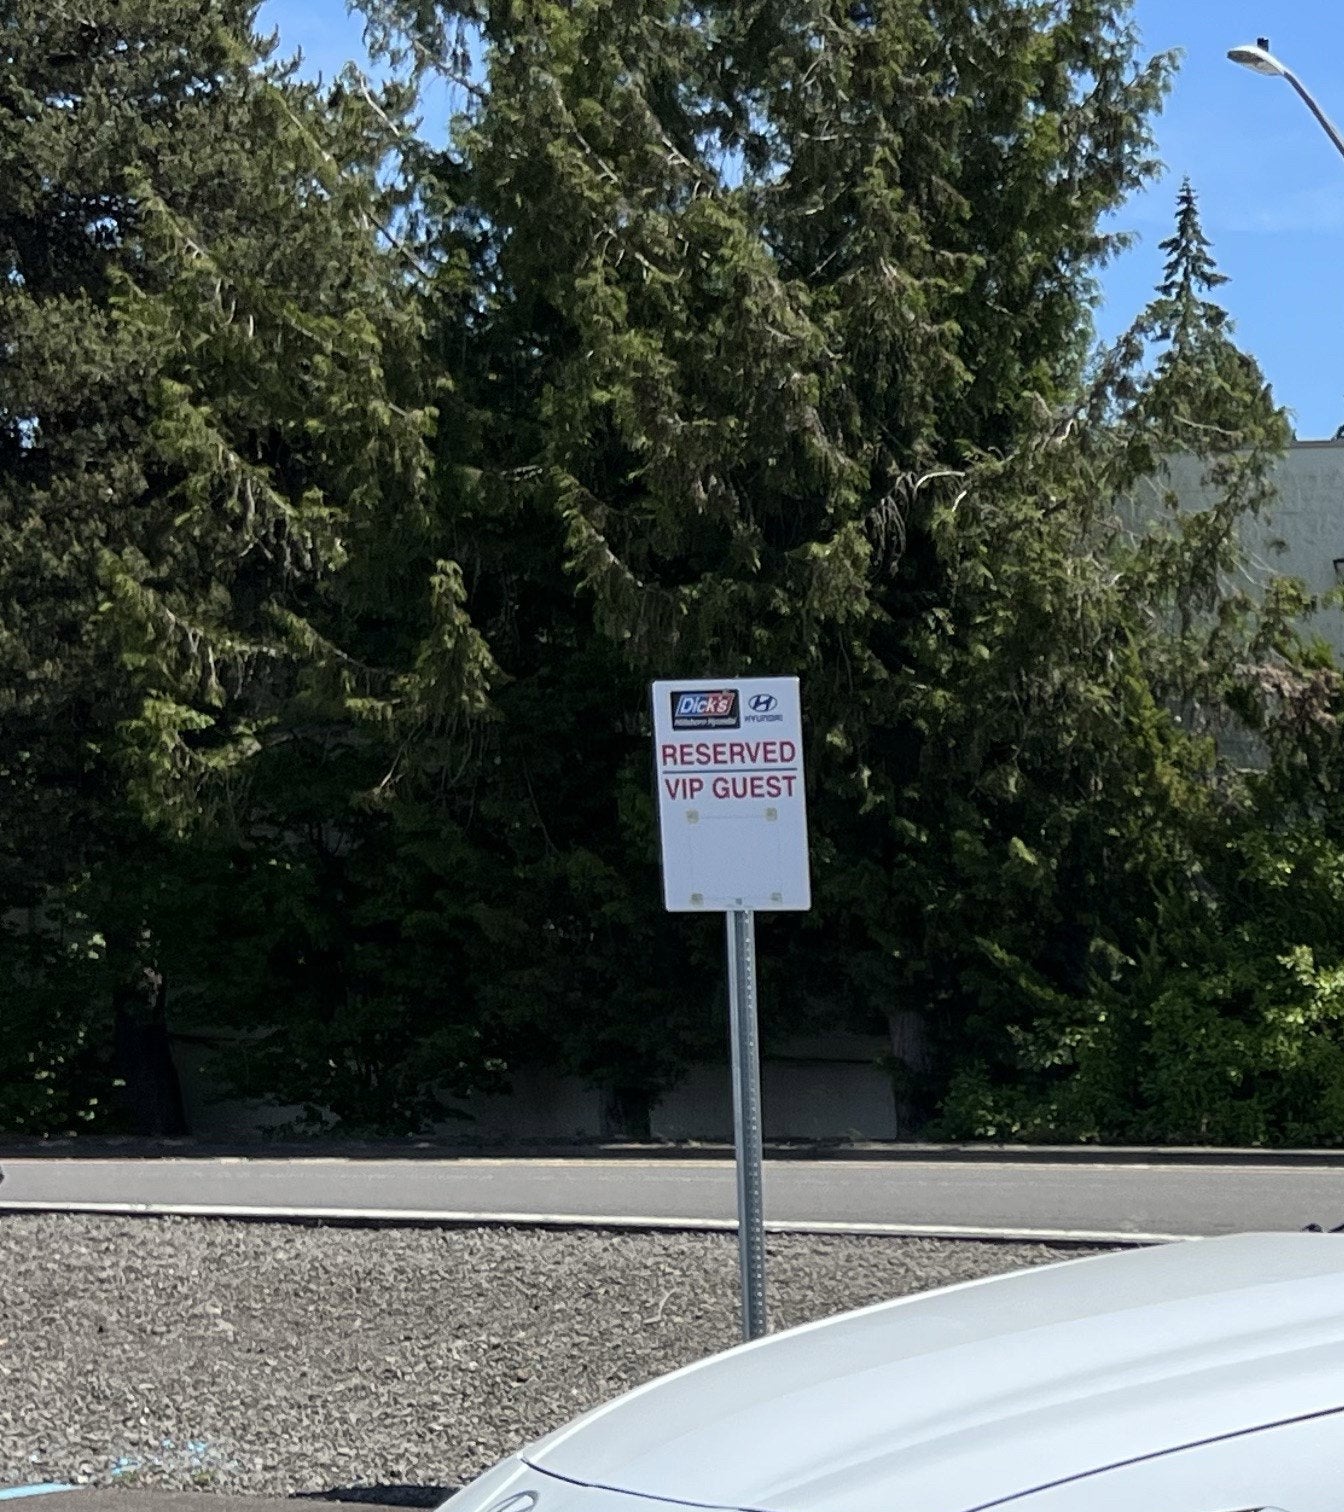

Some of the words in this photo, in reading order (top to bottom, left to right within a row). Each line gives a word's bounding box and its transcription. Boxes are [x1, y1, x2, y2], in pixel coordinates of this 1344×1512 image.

[661, 741, 796, 766] RESERVED
[665, 777, 704, 800] VIP
[712, 775, 797, 799] GUEST
